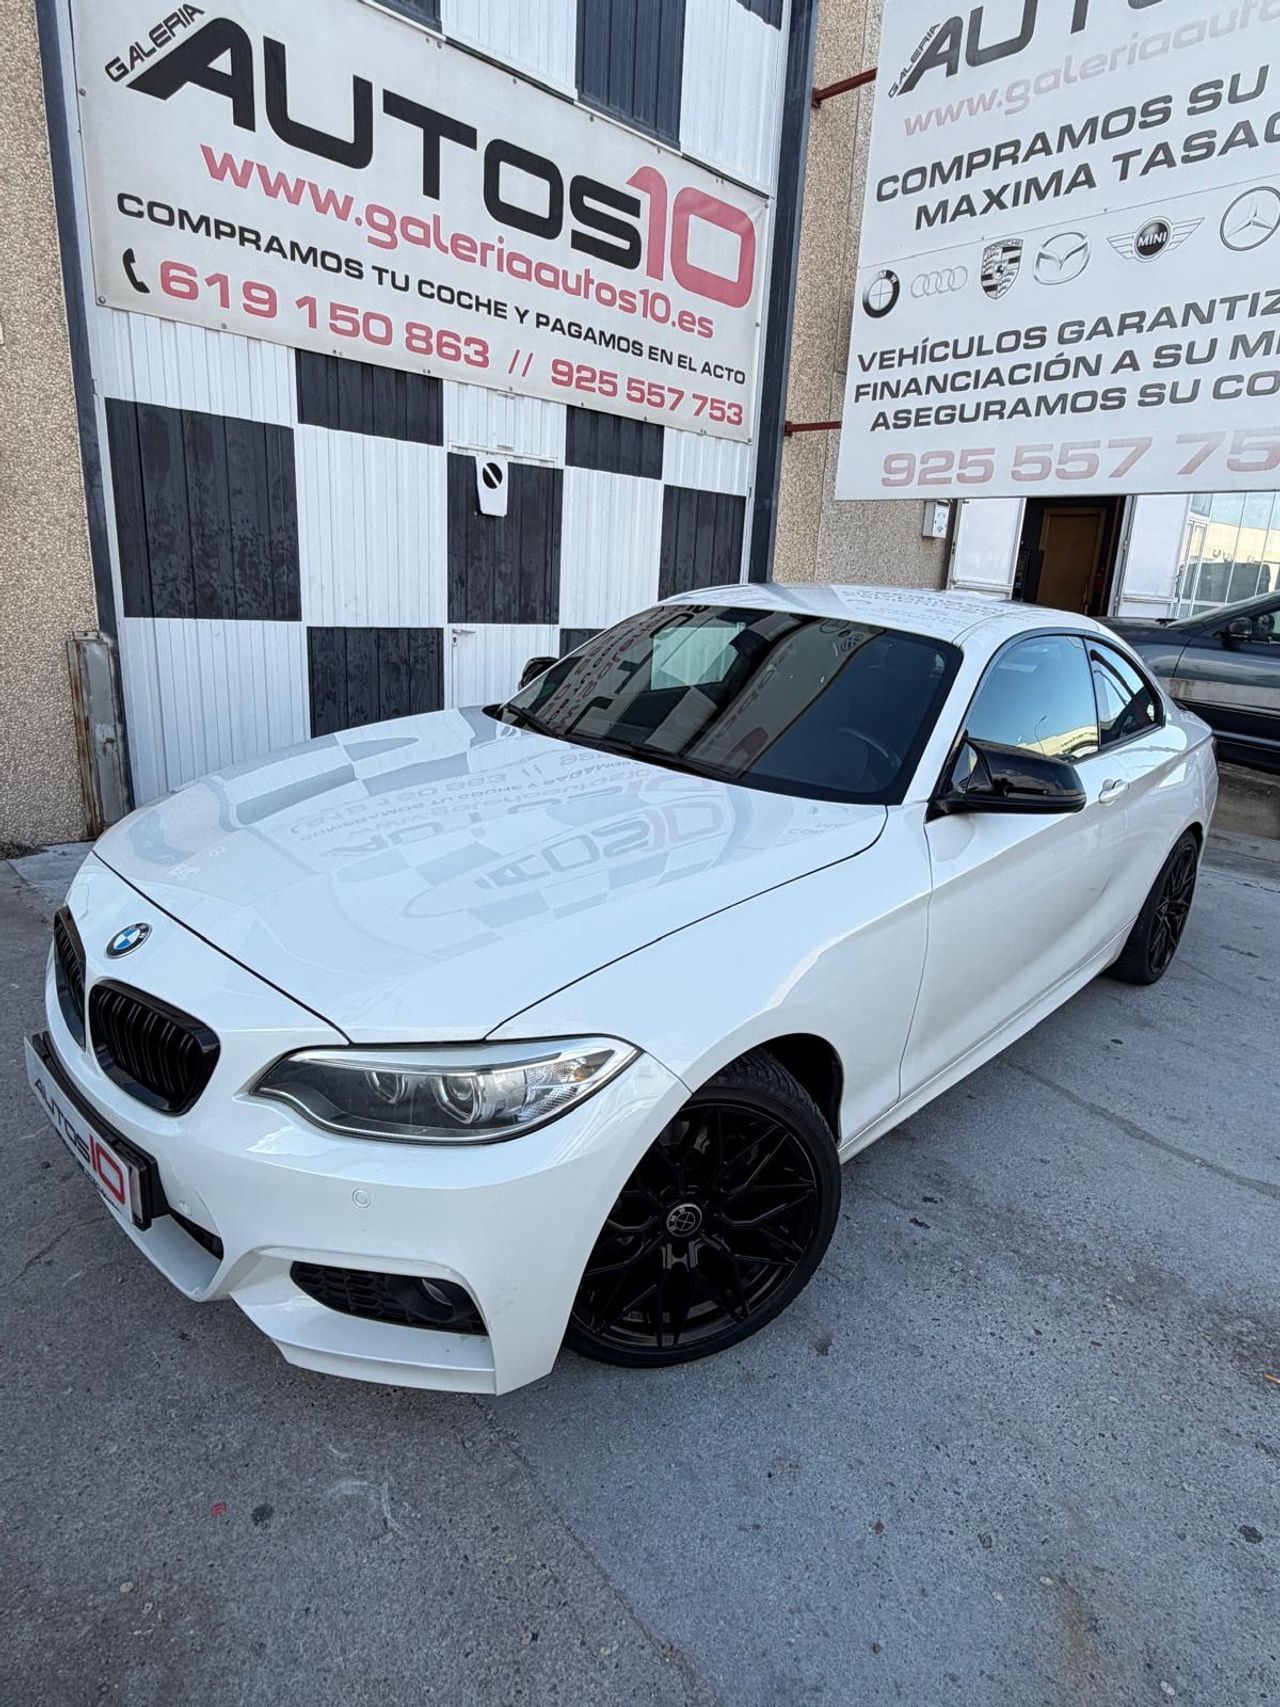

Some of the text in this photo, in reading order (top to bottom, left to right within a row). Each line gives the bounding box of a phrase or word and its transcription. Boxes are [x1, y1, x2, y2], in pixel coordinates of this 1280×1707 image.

[104, 3, 205, 83] GALERIA
[888, 22, 942, 98] GALERIA
[876, 64, 1270, 202] COMPRAMOS SU
[914, 162, 1097, 231] MAXIMA
[200, 143, 714, 339] www.galeriaautos10.es
[1138, 230, 1168, 248] MINI
[117, 192, 746, 385] COMPRAMOS TU COCHE Y PAGAMOS EN EL ACTO
[160, 260, 278, 319] 619
[295, 295, 393, 346] 150
[404, 321, 490, 369] 863
[551, 358, 618, 397] 925
[626, 379, 685, 411] 557
[692, 393, 744, 426] 753
[854, 352, 1102, 403] FINANCIACIÓN
[1110, 349, 1141, 374] A
[1152, 337, 1219, 370] SU
[857, 323, 1048, 374] VEHÍCULOS
[870, 387, 1127, 432] ASEGURAMOS
[1137, 379, 1201, 407] SU
[881, 447, 996, 488] 925
[1010, 436, 1153, 482] 557
